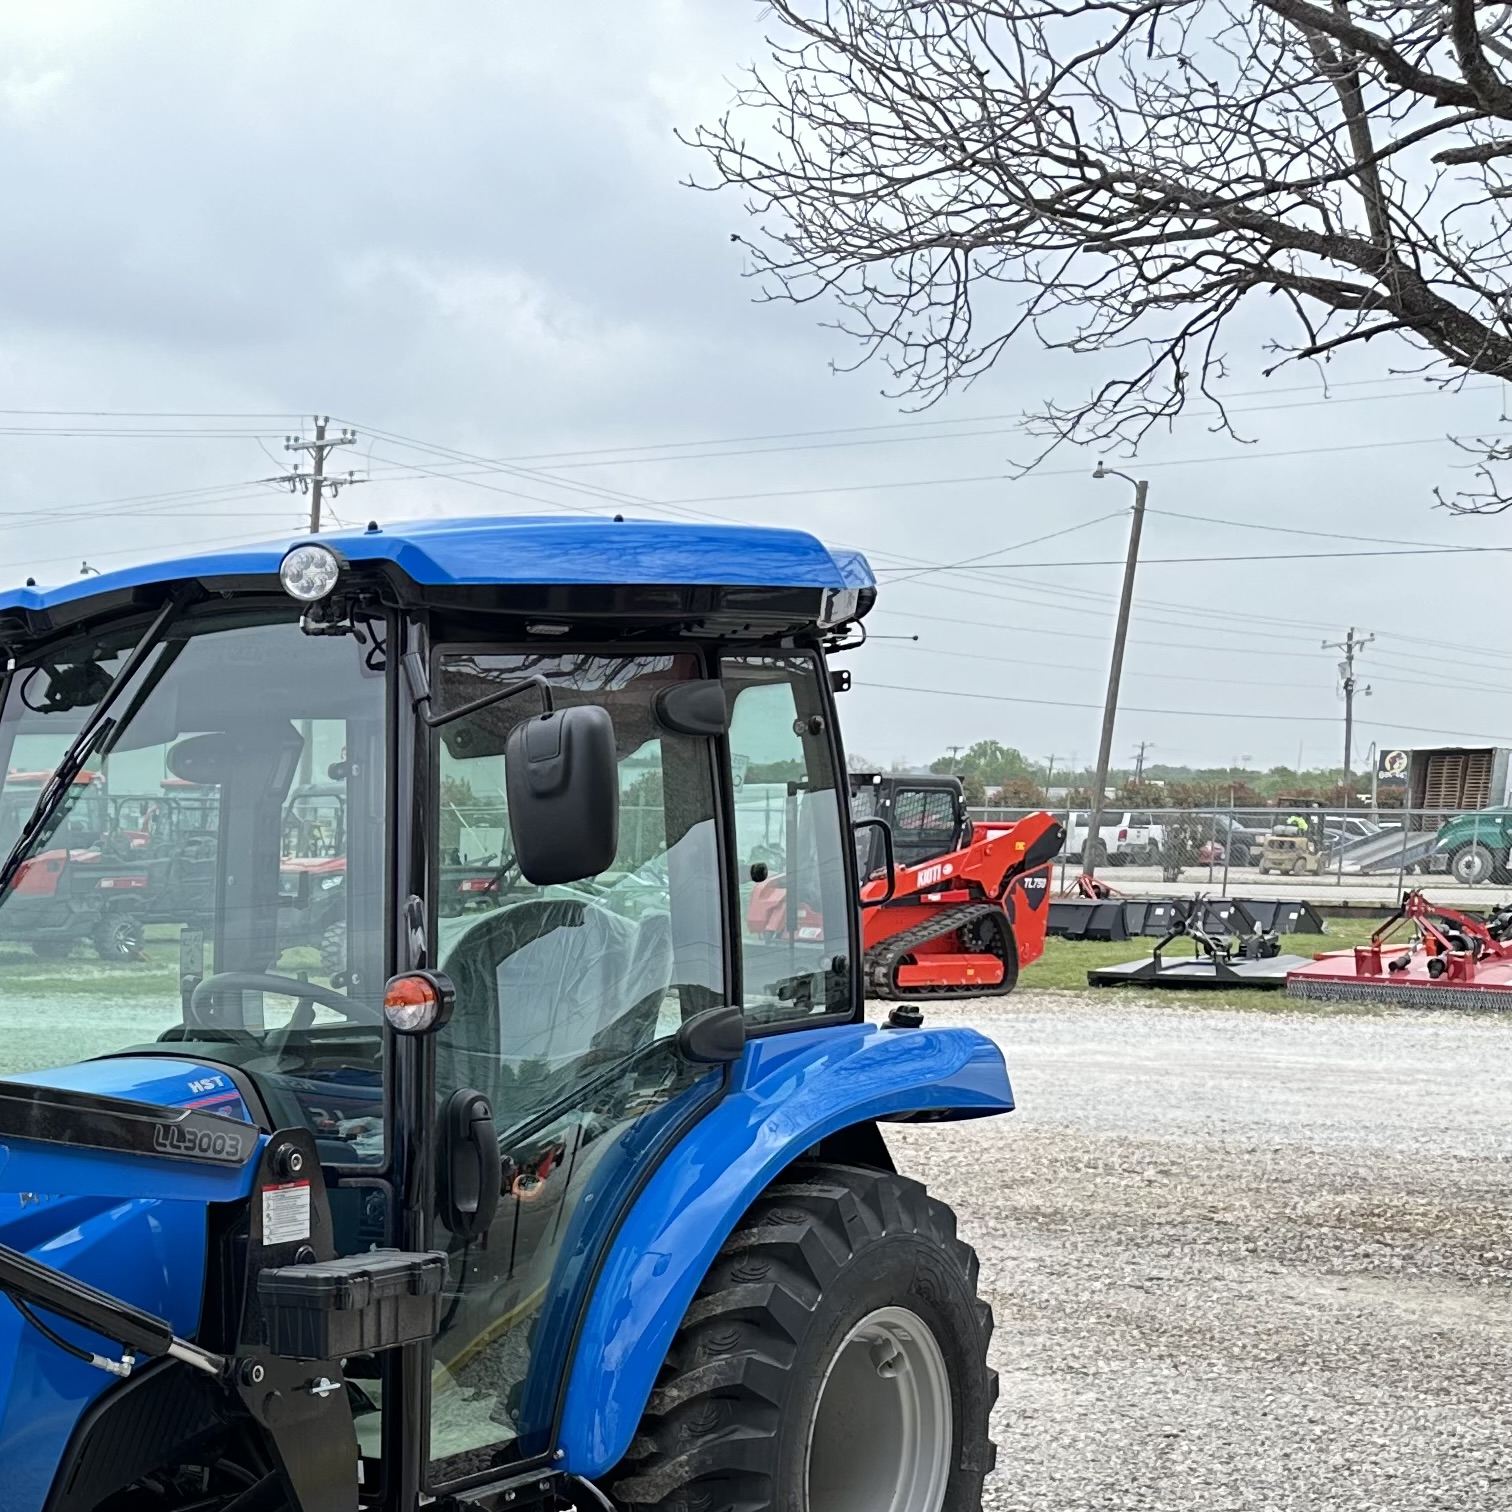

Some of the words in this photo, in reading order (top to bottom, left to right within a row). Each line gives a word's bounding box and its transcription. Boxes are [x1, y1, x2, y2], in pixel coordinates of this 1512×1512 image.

[917, 864, 941, 888] KIOTI
[188, 1075, 224, 1094] HST
[154, 1123, 243, 1158] LL3003
